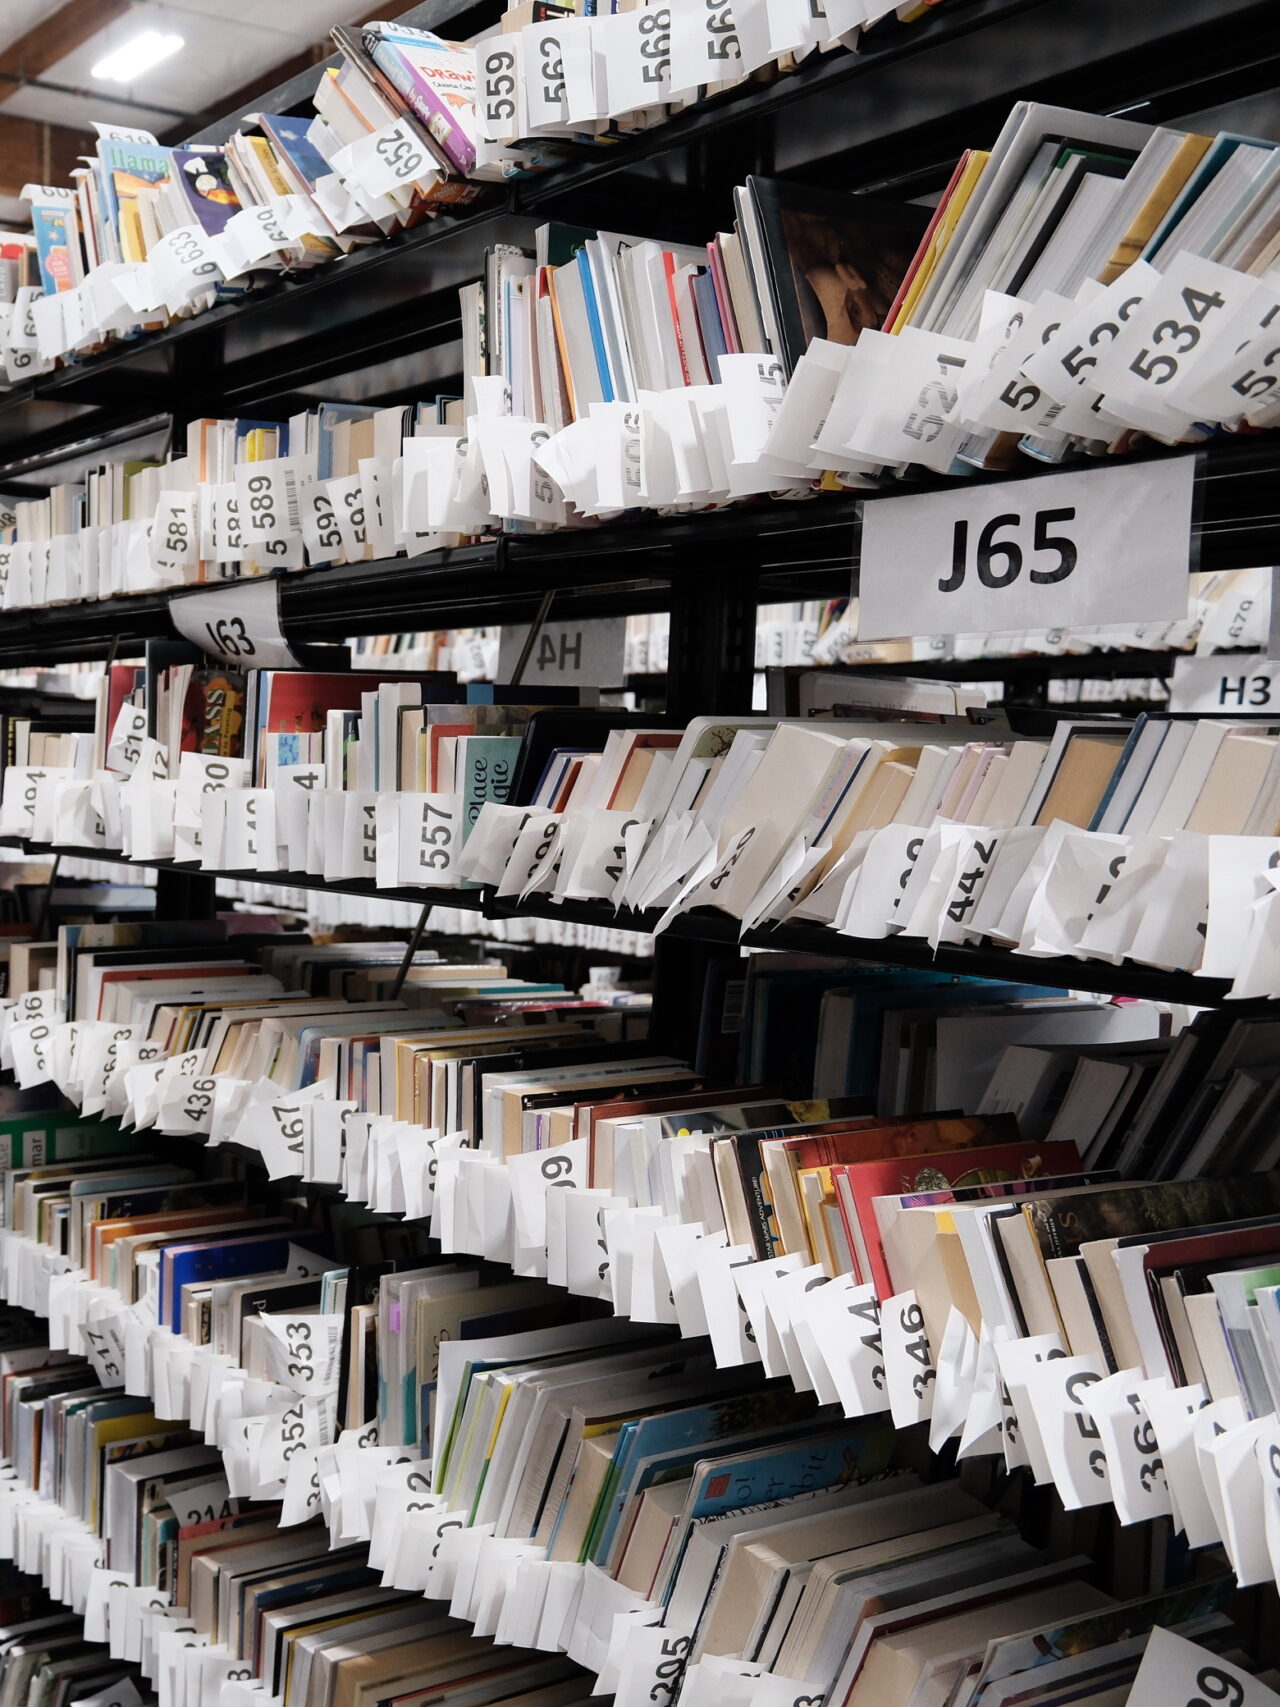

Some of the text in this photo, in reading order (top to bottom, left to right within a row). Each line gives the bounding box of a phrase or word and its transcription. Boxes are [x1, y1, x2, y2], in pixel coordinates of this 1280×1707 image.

[540, 37, 568, 103] 562
[639, 9, 670, 83] 568
[486, 51, 515, 120] 559
[375, 129, 424, 179] 652
[1130, 286, 1227, 385] 534
[903, 353, 967, 443] 521
[166, 507, 189, 553] 581
[248, 475, 276, 529] 589
[937, 507, 1079, 593] J65
[1220, 674, 1271, 706] H3
[419, 802, 453, 870] 557
[946, 838, 998, 923] 442
[183, 1079, 217, 1121] 436
[761, 1221, 770, 1241] WARS
[766, 1242, 774, 1259] STAR
[87, 1330, 120, 1377] 317
[286, 1322, 314, 1382] 353
[848, 1296, 887, 1391] 344
[899, 1303, 937, 1400] 346
[281, 1403, 307, 1463] 352
[1125, 1393, 1169, 1493] 361
[187, 1499, 235, 1526] 214
